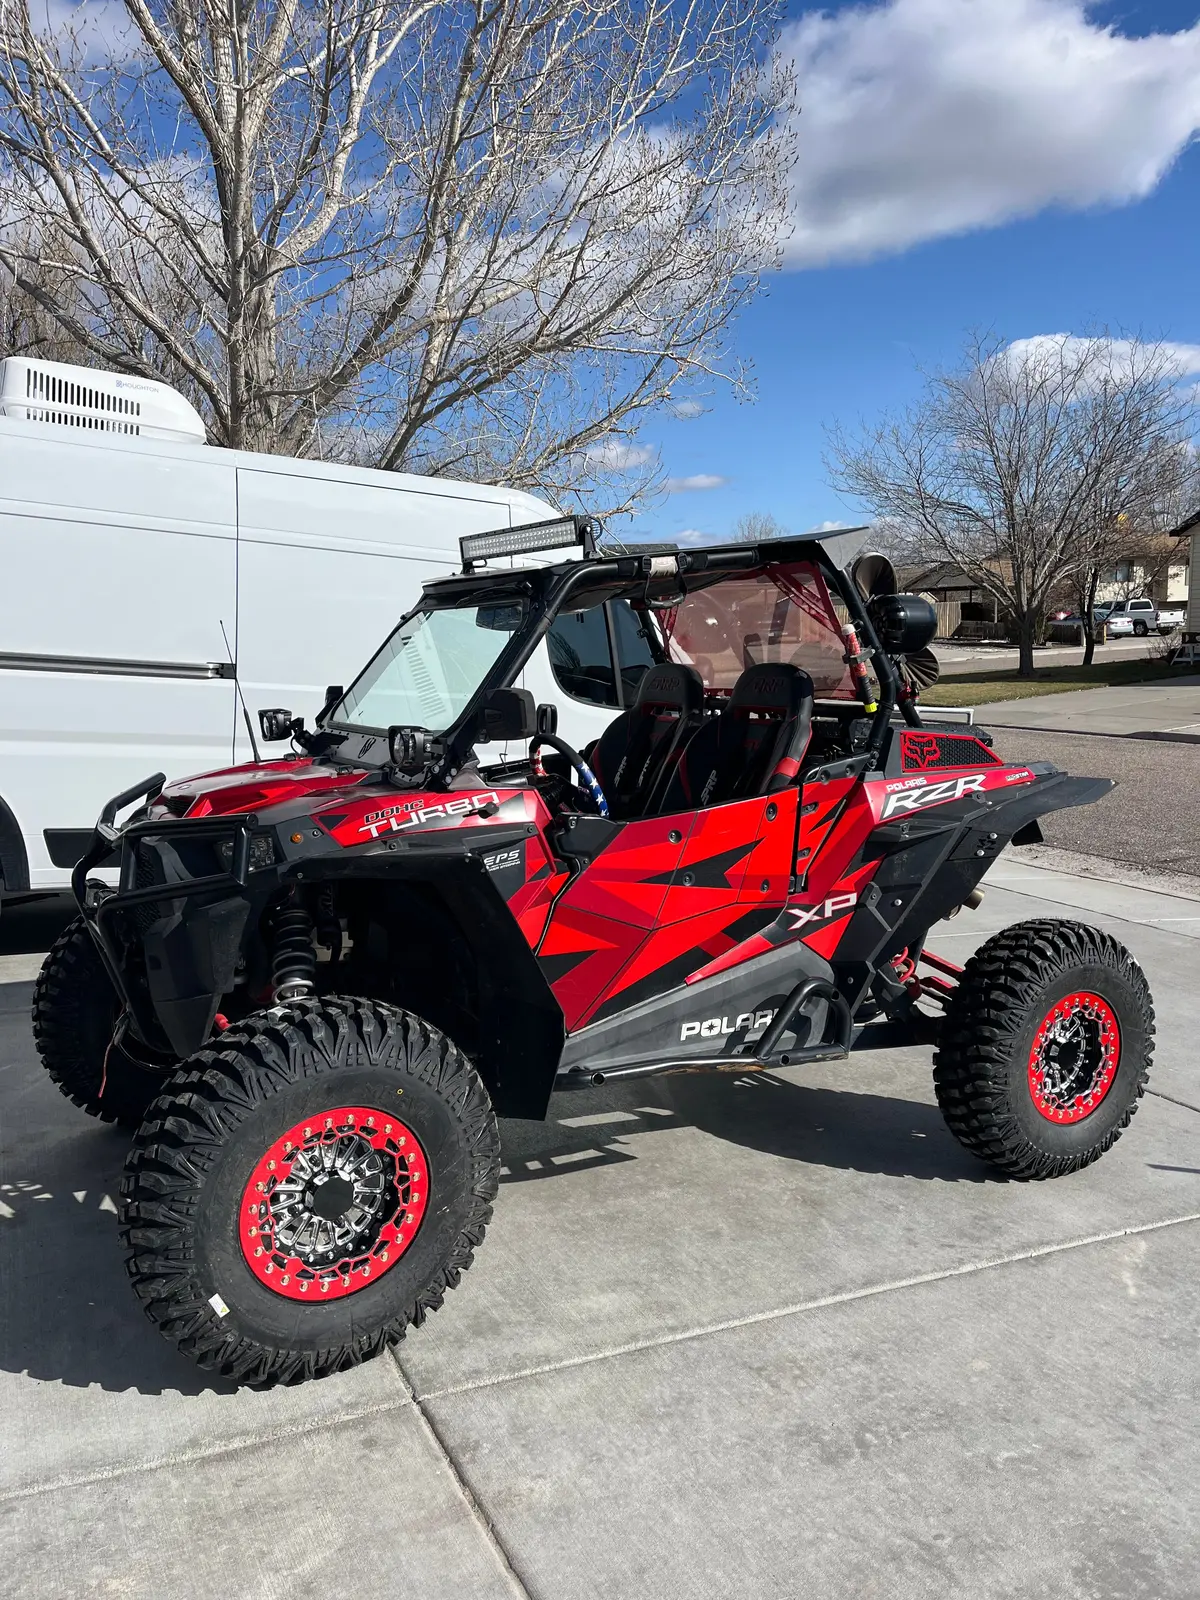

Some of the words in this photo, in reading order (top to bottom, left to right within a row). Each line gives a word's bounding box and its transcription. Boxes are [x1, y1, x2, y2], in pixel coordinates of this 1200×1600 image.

[123, 382, 159, 393] HOUGHTON
[883, 774, 987, 818] RZR
[886, 777, 928, 792] POLARIS
[358, 791, 501, 838] TURBO
[364, 799, 424, 824] DOHC
[484, 849, 521, 866] EPS
[786, 892, 858, 931] XP
